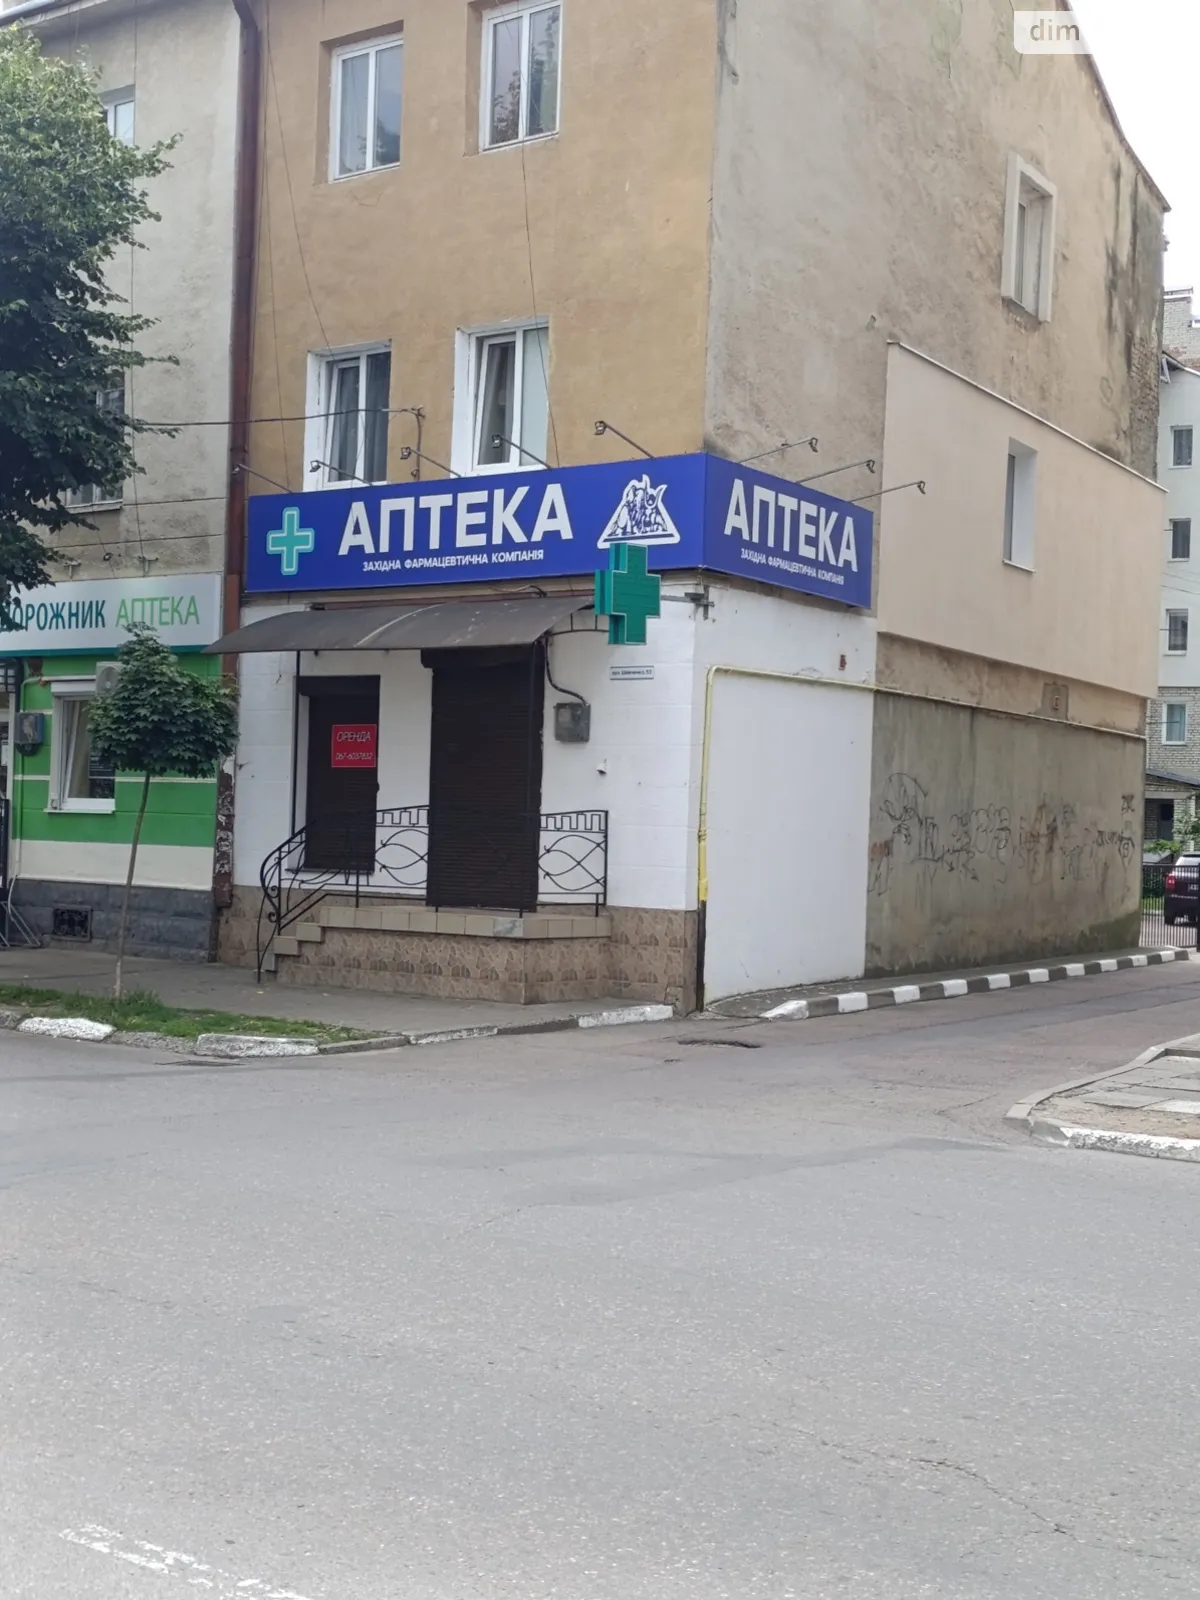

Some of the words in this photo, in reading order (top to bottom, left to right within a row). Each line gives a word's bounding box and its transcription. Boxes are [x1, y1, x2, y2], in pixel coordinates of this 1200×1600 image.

[338, 483, 573, 556] АПТЕКА
[723, 478, 858, 573] АПТЕКА
[362, 560, 401, 572] ЗАХІДНА
[404, 553, 489, 569] ФАРМАЦЕВТИЧНА
[491, 549, 544, 563] КОМПАНІЯ
[741, 548, 767, 565] ЗАХІДНА
[768, 557, 817, 578] ФАРМАЦЕВТИЧНА
[817, 569, 845, 585] КОМПАНІЯ
[1, 599, 106, 632] ОРОЖНИК
[115, 595, 200, 627] АПТЕКА
[336, 731, 371, 742] ОРЕНДА
